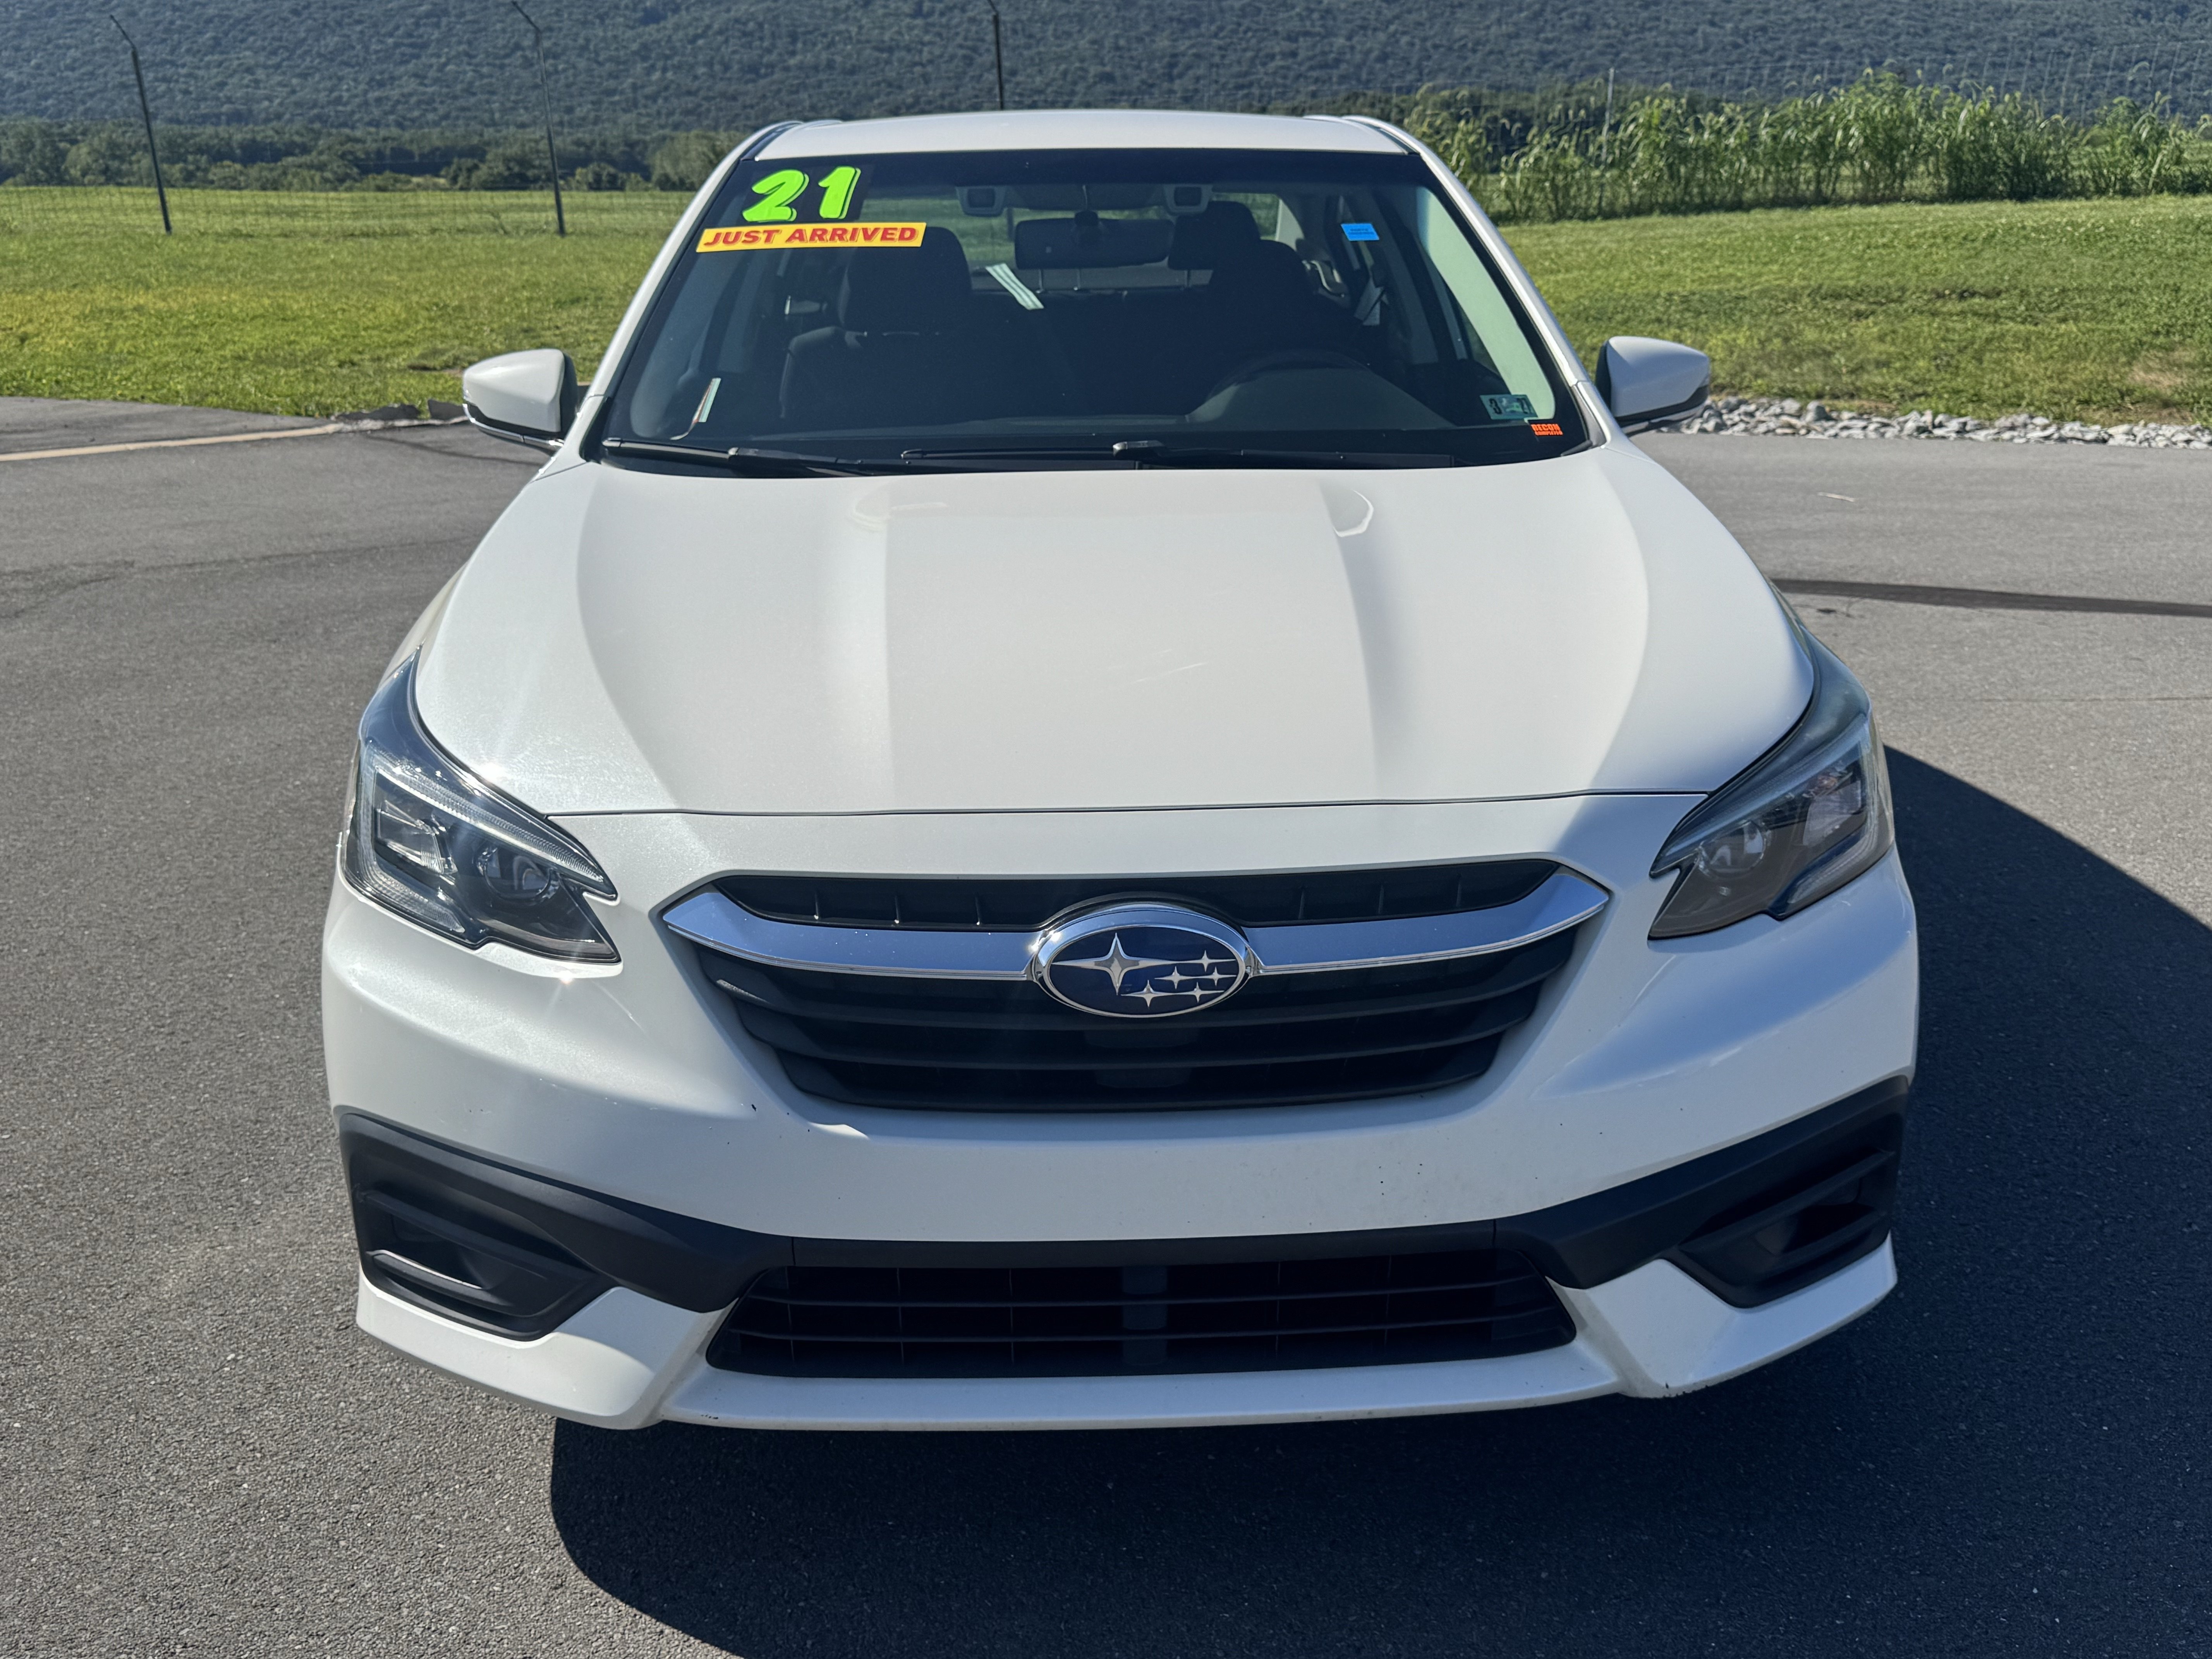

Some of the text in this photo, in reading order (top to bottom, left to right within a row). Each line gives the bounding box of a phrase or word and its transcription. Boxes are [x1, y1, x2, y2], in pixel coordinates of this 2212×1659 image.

[742, 166, 860, 222] 21
[704, 227, 918, 246] JUST ARRIVED
